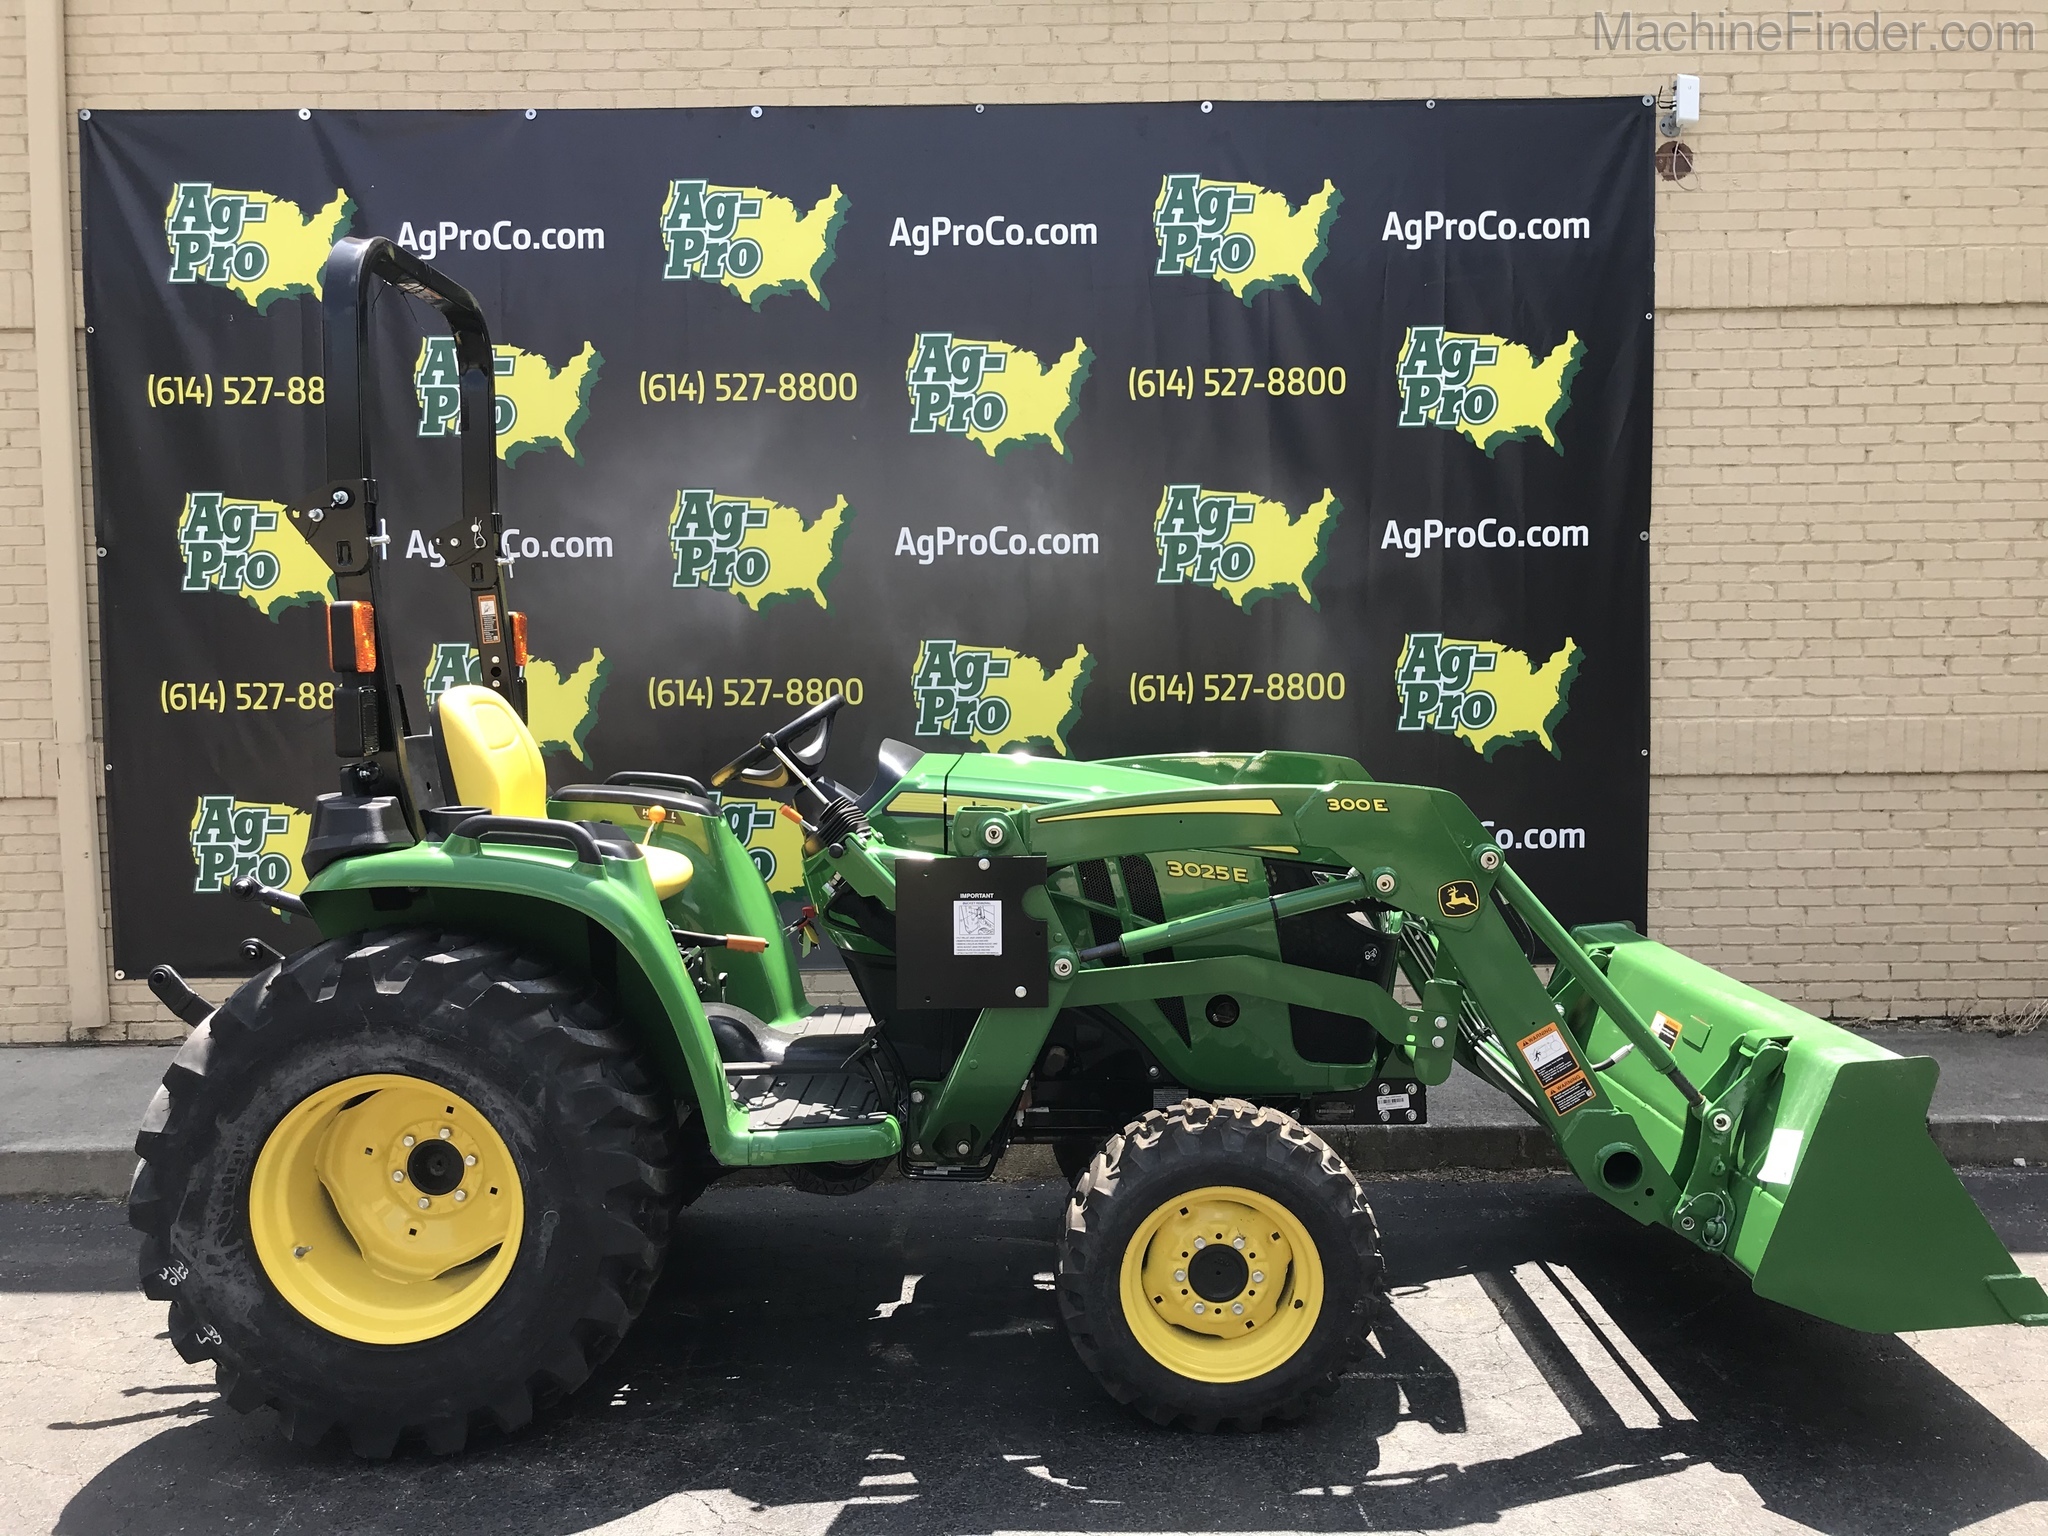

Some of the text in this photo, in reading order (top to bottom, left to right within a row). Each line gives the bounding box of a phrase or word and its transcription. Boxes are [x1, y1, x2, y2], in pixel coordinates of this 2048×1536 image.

[168, 183, 266, 241] Ag-
[663, 180, 761, 238] Ag-
[1157, 174, 1254, 233] Ag-
[397, 221, 605, 260] AgProCo.com
[890, 216, 1097, 256] AgProCo.com
[1156, 226, 1254, 274] Pro
[1382, 210, 1590, 250] AgProCo.com
[169, 233, 268, 282] Pro
[664, 231, 763, 280] Pro
[417, 337, 514, 388] A-
[909, 334, 1006, 392] Ag-
[1400, 327, 1497, 386] Ag-
[147, 374, 325, 407] (614) 527-88
[639, 371, 858, 404] (614) 527-8800
[1129, 366, 1346, 400] (614) 527-8800
[1399, 378, 1497, 426] Pro
[419, 386, 515, 435] Po
[910, 385, 1006, 432] Pro
[183, 493, 276, 548] Ag-
[673, 490, 767, 547] Ag-
[1160, 485, 1253, 544] Ag-
[406, 528, 613, 568] AgCo.com
[895, 526, 1099, 564] AgProCo.com
[1157, 536, 1253, 583] Pro
[1381, 519, 1589, 558] AgProCo.com
[183, 543, 279, 590] Pro
[673, 540, 769, 587] Pro
[916, 640, 1009, 696] Ag-
[1399, 634, 1496, 691] Ag-
[160, 681, 336, 714] (614) 527-88
[648, 677, 864, 709] (614) 527-8800
[916, 689, 1009, 735] Pro
[1130, 672, 1346, 705] (614) 527-8800
[1398, 684, 1496, 730] Pro
[193, 796, 288, 855] Ag-
[196, 843, 290, 892] Pro
[1529, 1027, 1553, 1042] WARNING
[1557, 1075, 1581, 1090] WARNING
